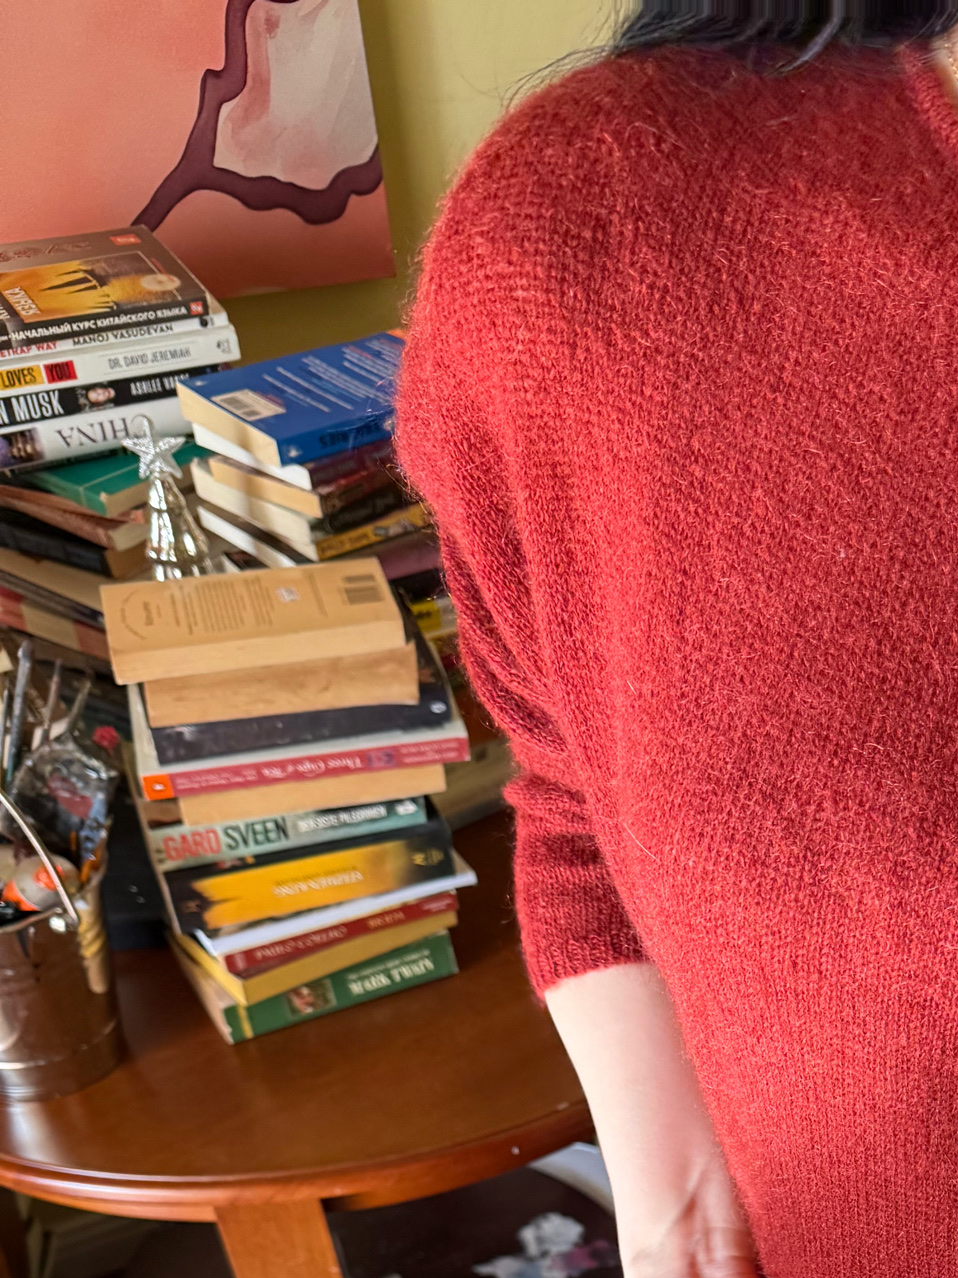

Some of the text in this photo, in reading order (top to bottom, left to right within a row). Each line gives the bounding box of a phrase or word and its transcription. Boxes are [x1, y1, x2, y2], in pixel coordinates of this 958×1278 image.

[12, 321, 71, 340] НАЧАЛЬНЫЙ
[72, 319, 96, 331] КУРС
[97, 312, 156, 327] КИТАЙСКОГО
[157, 307, 188, 320] ЯЗЫКА
[73, 330, 109, 346] MANOJ
[124, 353, 148, 367] DAVID
[151, 348, 191, 364] JEREMIAH
[1, 363, 70, 387] LOVES YOU
[11, 390, 64, 422] MUSK
[163, 828, 222, 862] GARD
[225, 817, 290, 851] SVEEN
